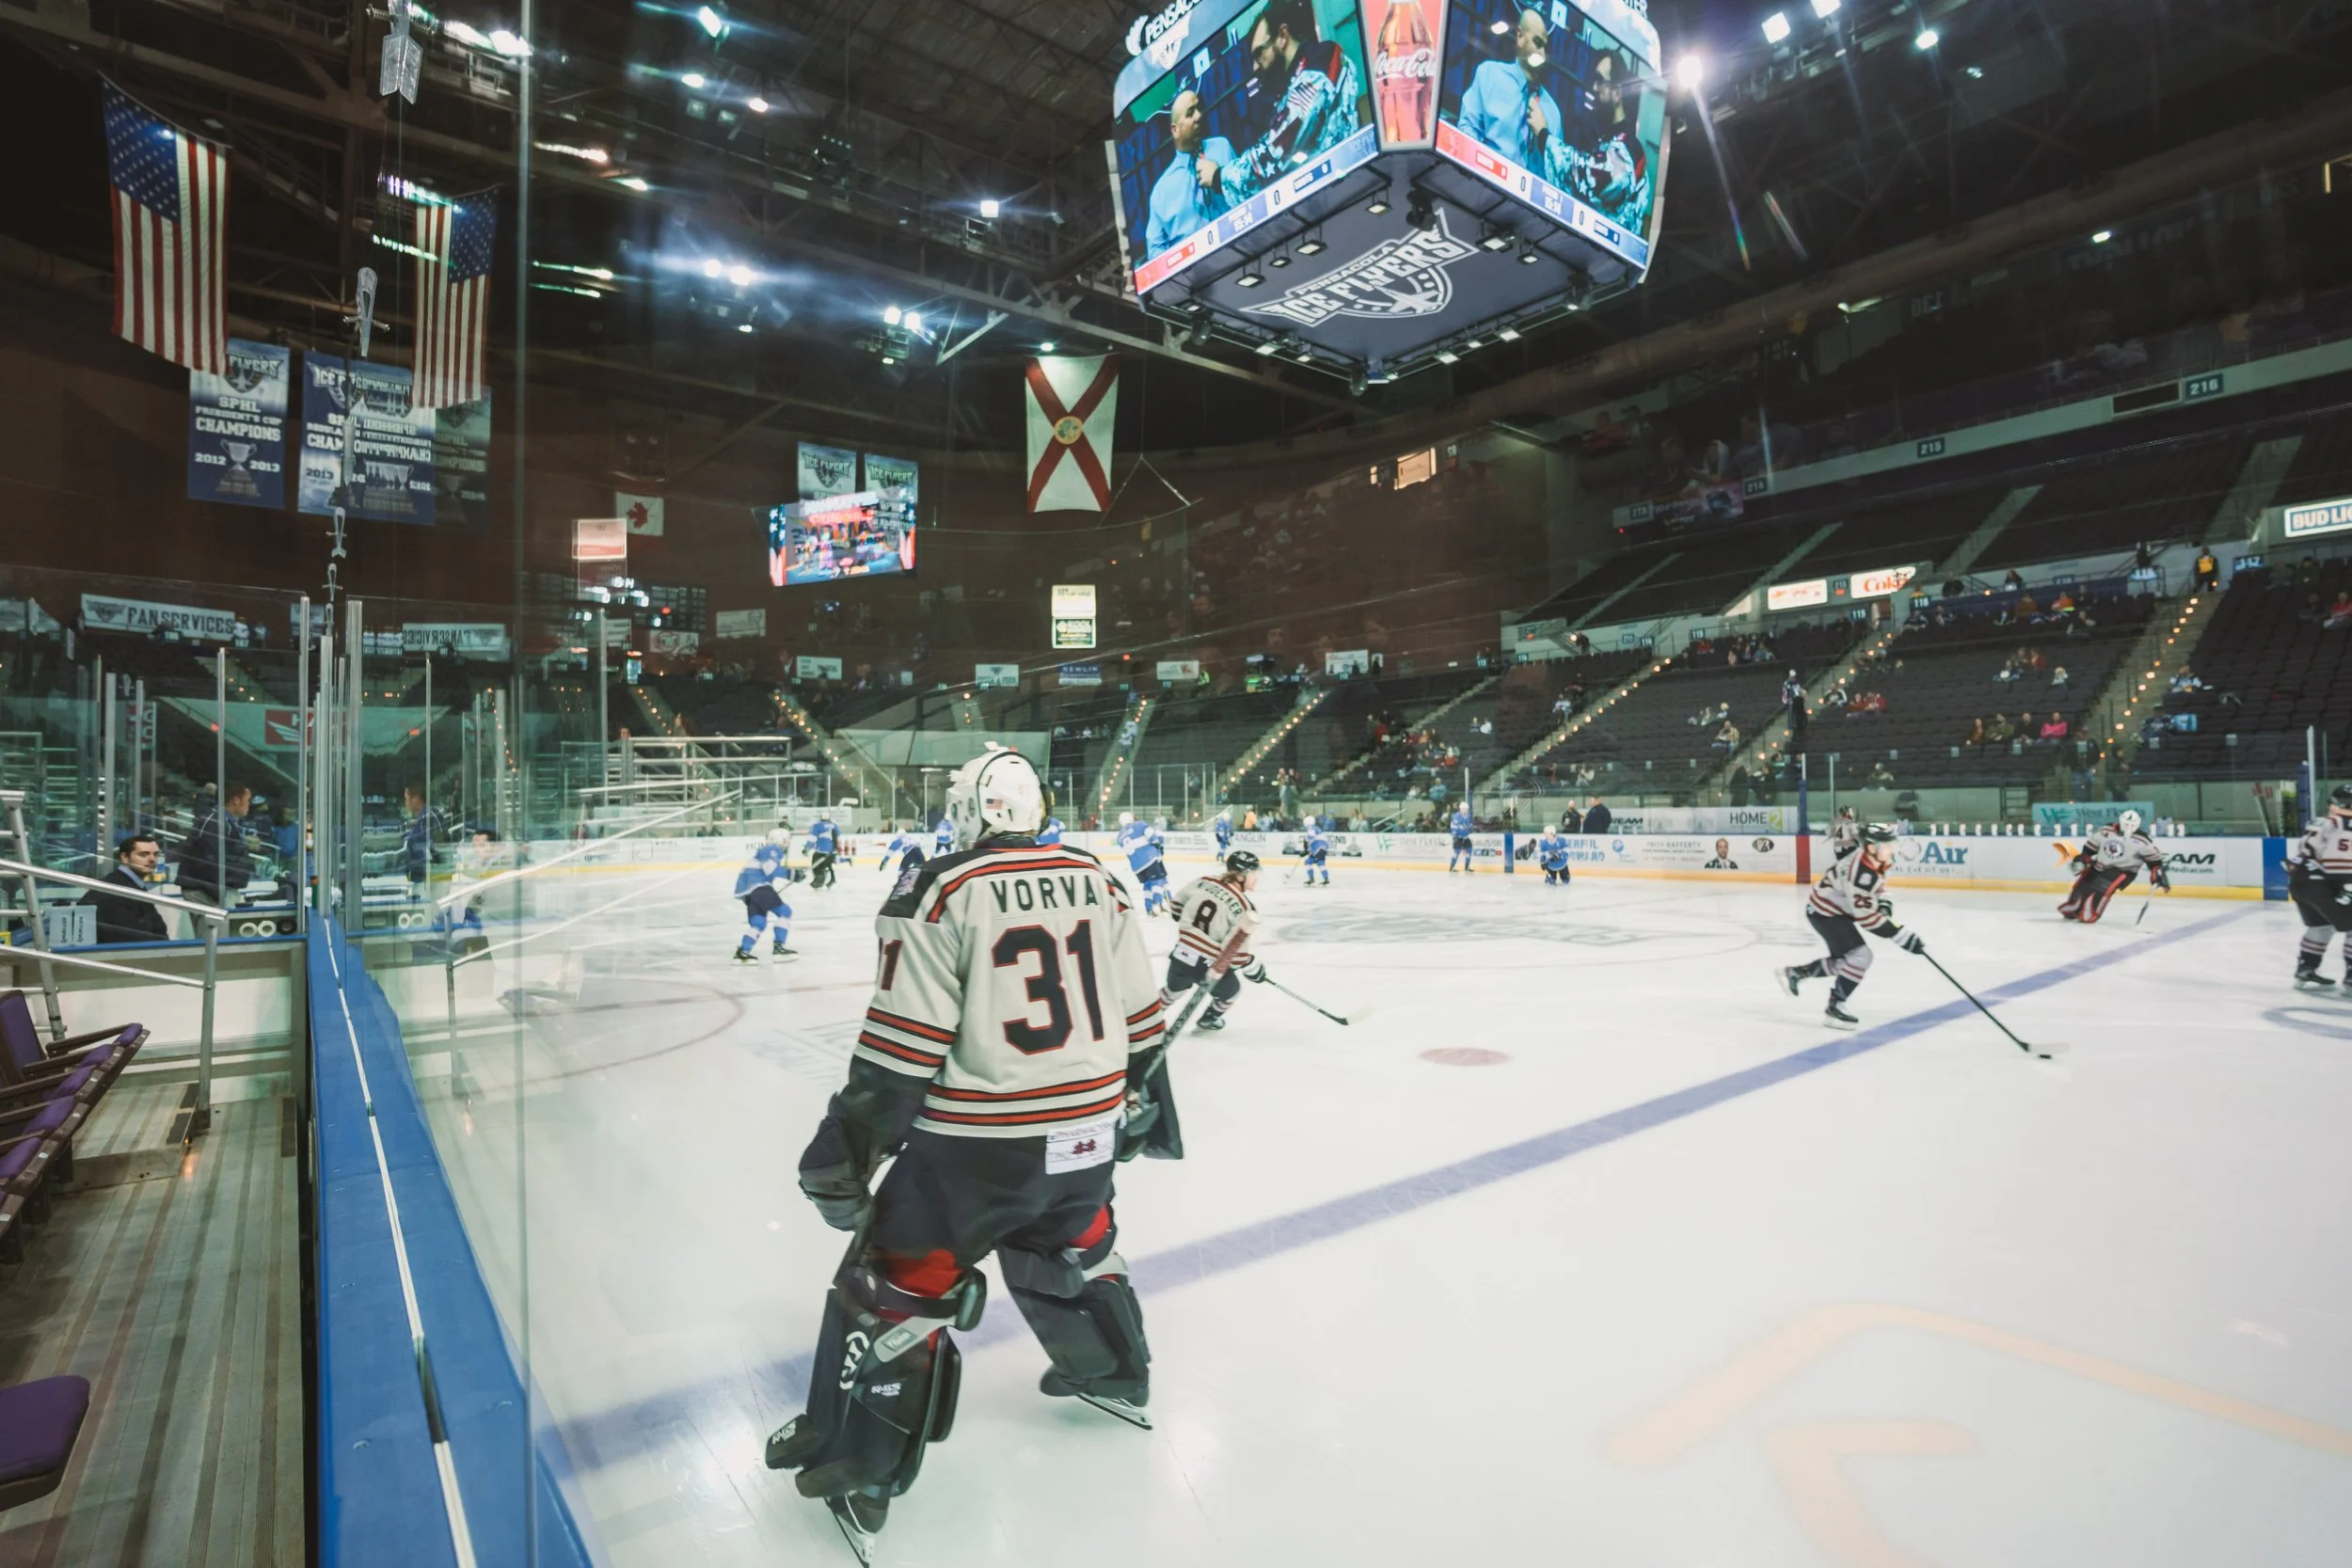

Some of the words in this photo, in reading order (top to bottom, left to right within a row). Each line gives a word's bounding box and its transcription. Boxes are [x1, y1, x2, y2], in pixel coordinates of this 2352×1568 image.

[1260, 293, 1344, 324] ICE
[1326, 227, 1467, 301] FLYERS
[1296, 245, 1397, 296] PENSACOLA
[2190, 379, 2219, 395] 216
[218, 396, 262, 413] SPHL
[195, 417, 281, 442] CHAMPIONS
[195, 452, 227, 466] 2012
[1920, 440, 1942, 455] 215
[249, 460, 280, 472] 2013
[2293, 509, 2329, 531] BUD
[990, 874, 1100, 913] VORVA
[1852, 894, 1873, 909] 25
[1191, 898, 1217, 936] 8
[879, 938, 903, 992] 1
[991, 919, 1104, 1056] 31
